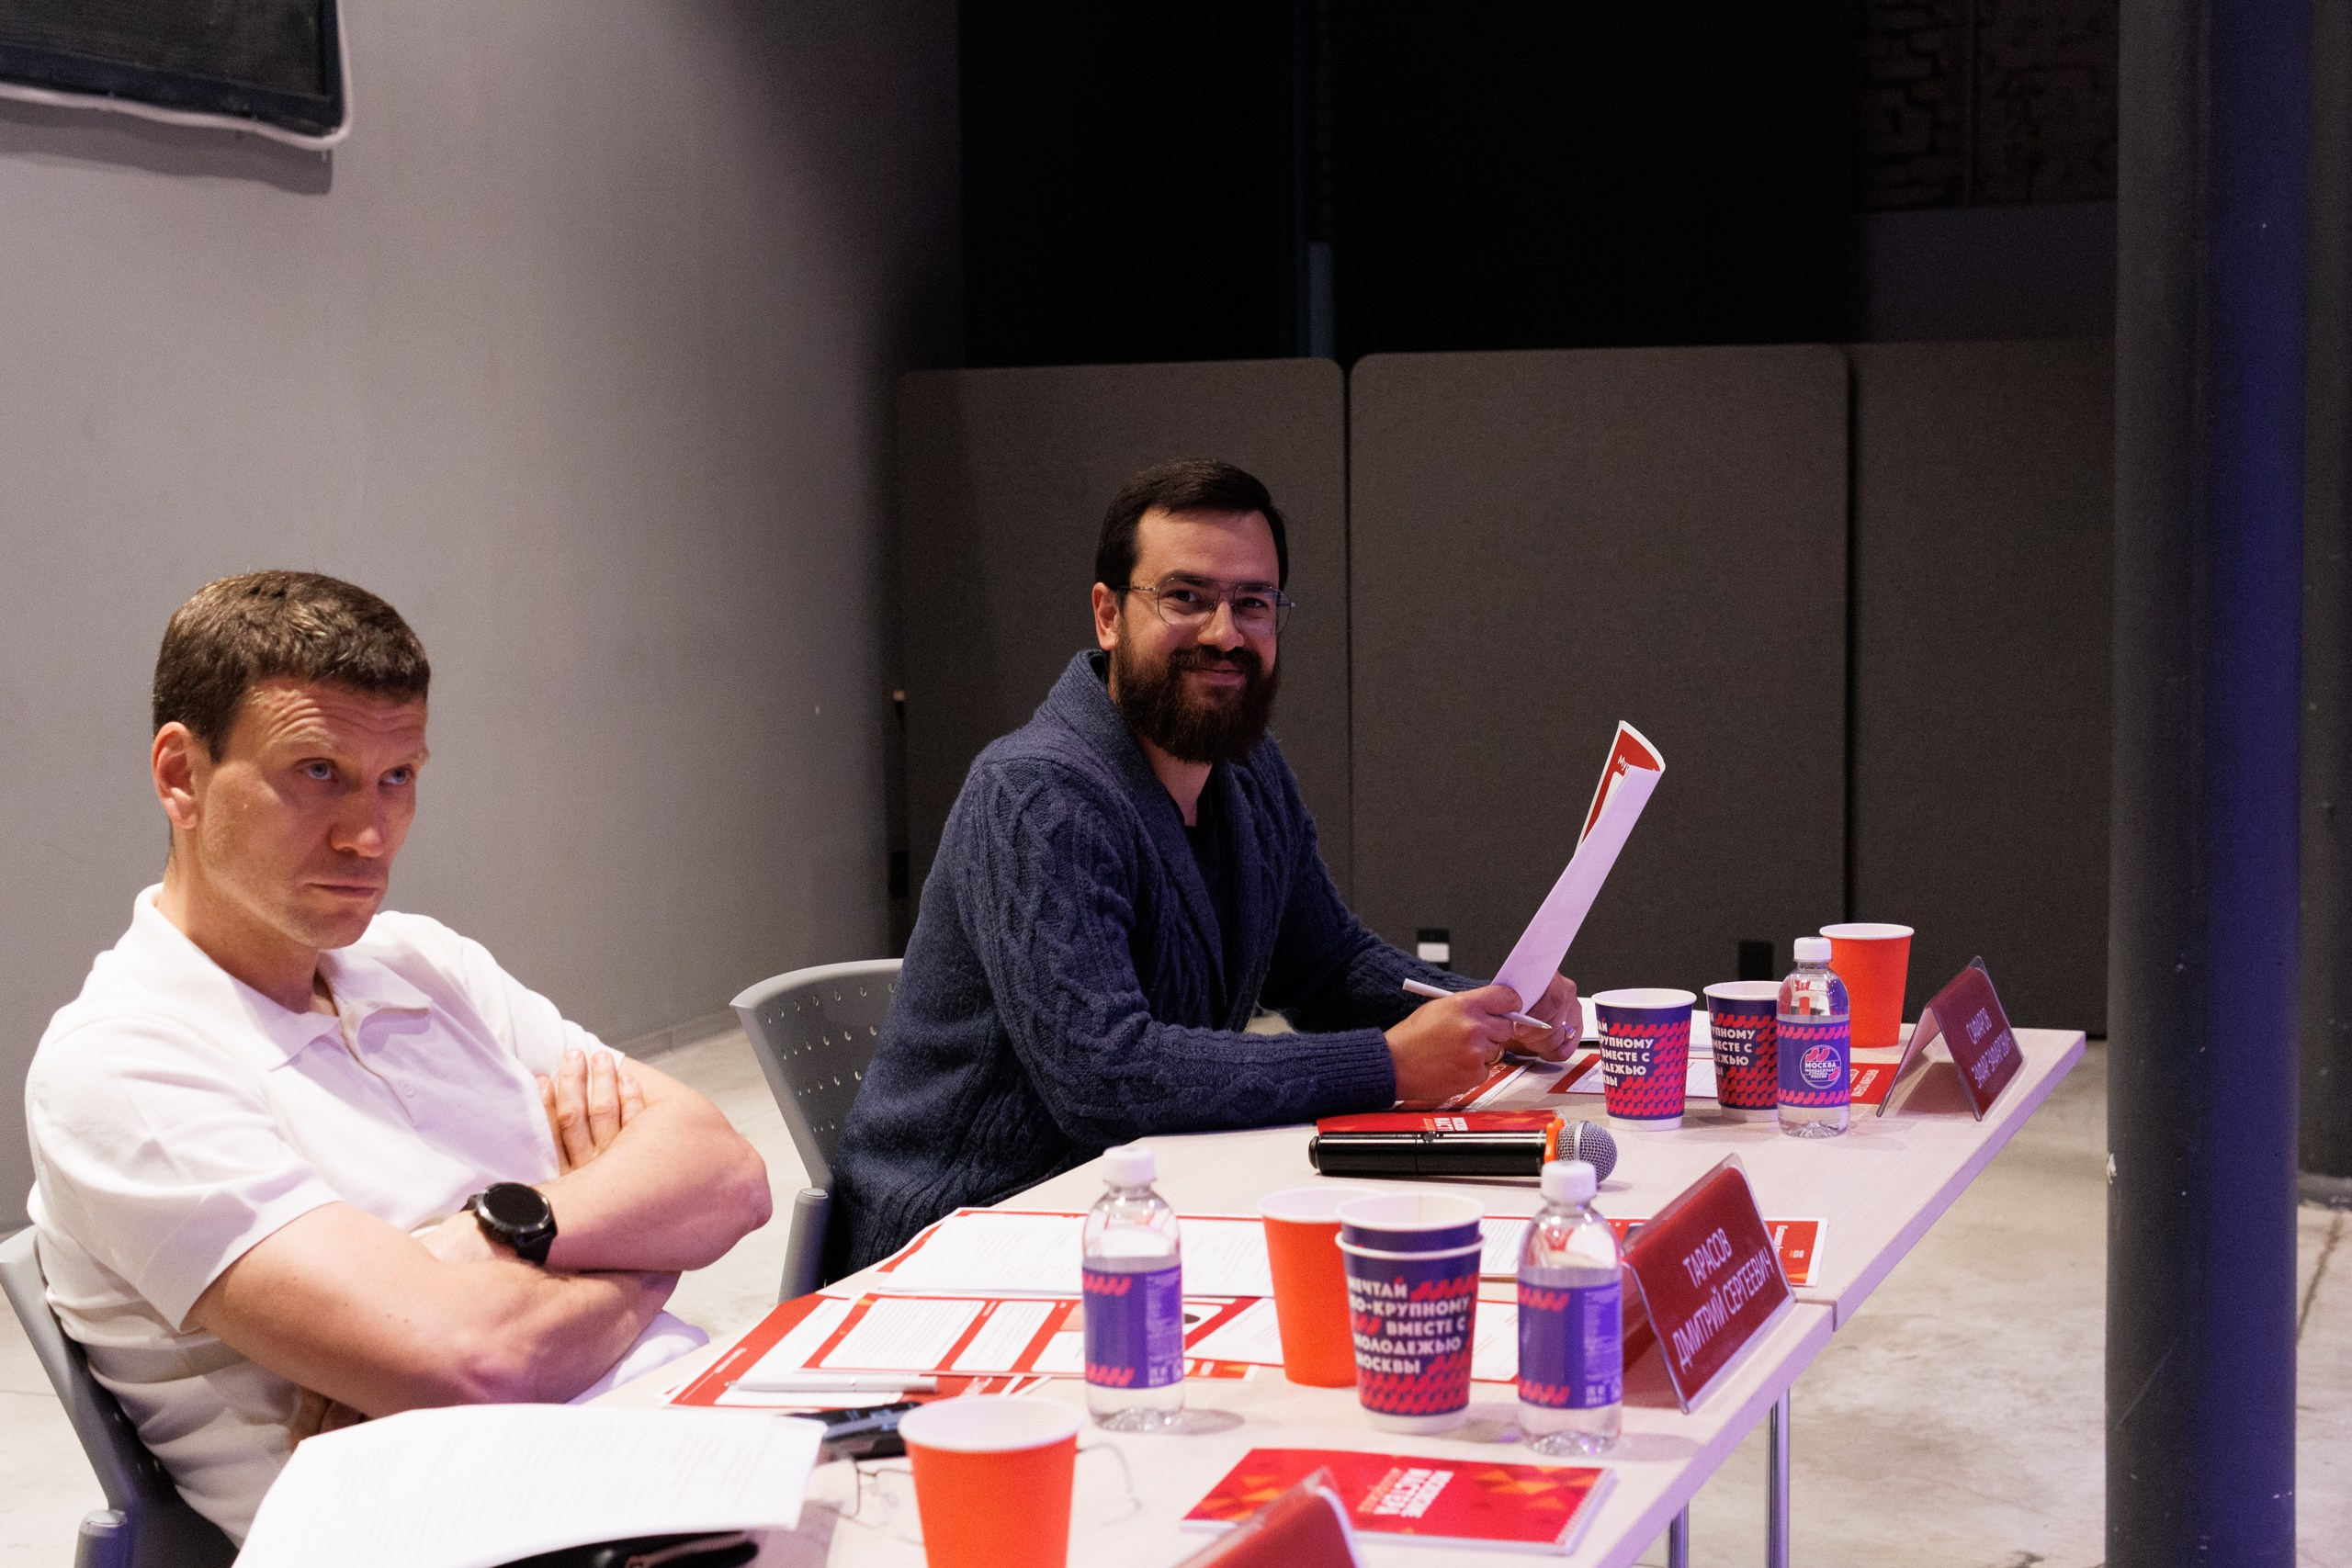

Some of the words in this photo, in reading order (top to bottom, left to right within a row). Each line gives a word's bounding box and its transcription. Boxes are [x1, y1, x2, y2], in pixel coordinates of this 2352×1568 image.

[1713, 1039, 1740, 1053] МЕСТЕ
[1744, 1043, 1752, 1053] С
[1642, 1053, 1650, 1063] С
[1804, 1061, 1837, 1069] МОСКВА
[1682, 1227, 1733, 1289] ТАРАСОВ
[1672, 1286, 1730, 1374] ДМИТРИЙ
[1723, 1246, 1775, 1315] СЕРГЕЕВИЧ
[1385, 1318, 1453, 1337] ВМЕСТЕ
[1456, 1315, 1466, 1332] С
